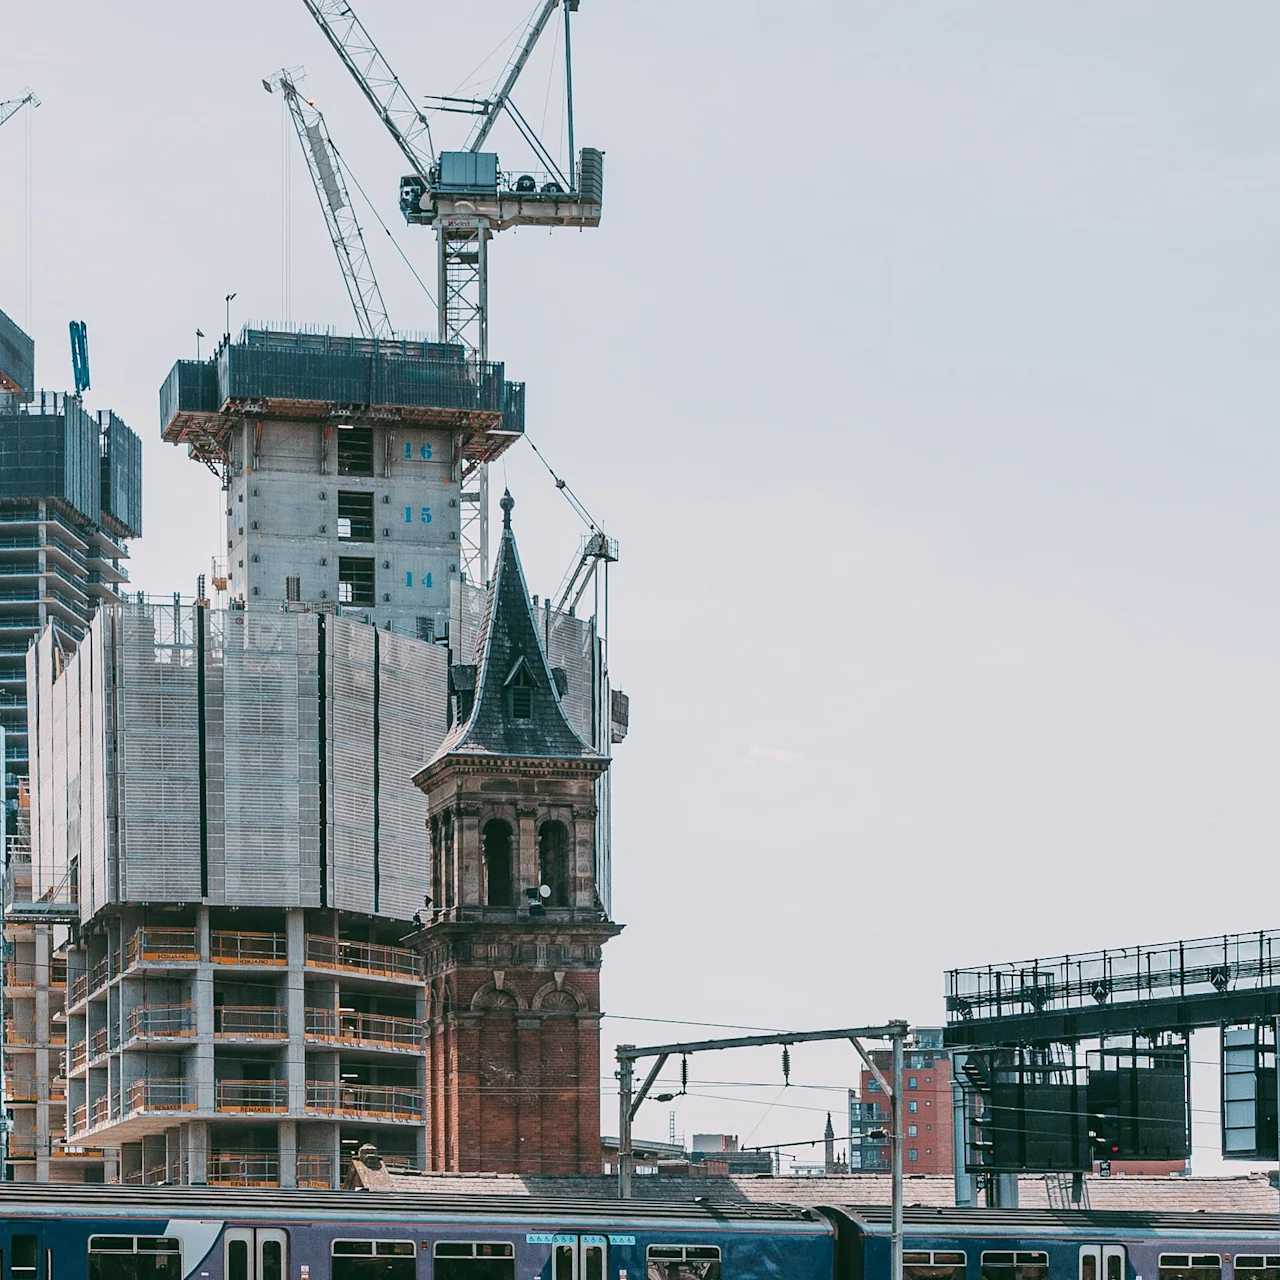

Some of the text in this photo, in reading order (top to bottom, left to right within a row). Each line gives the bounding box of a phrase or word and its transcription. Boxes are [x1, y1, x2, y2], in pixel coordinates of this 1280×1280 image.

[404, 442, 433, 460] 16
[404, 506, 433, 524] 15
[405, 571, 433, 588] 14
